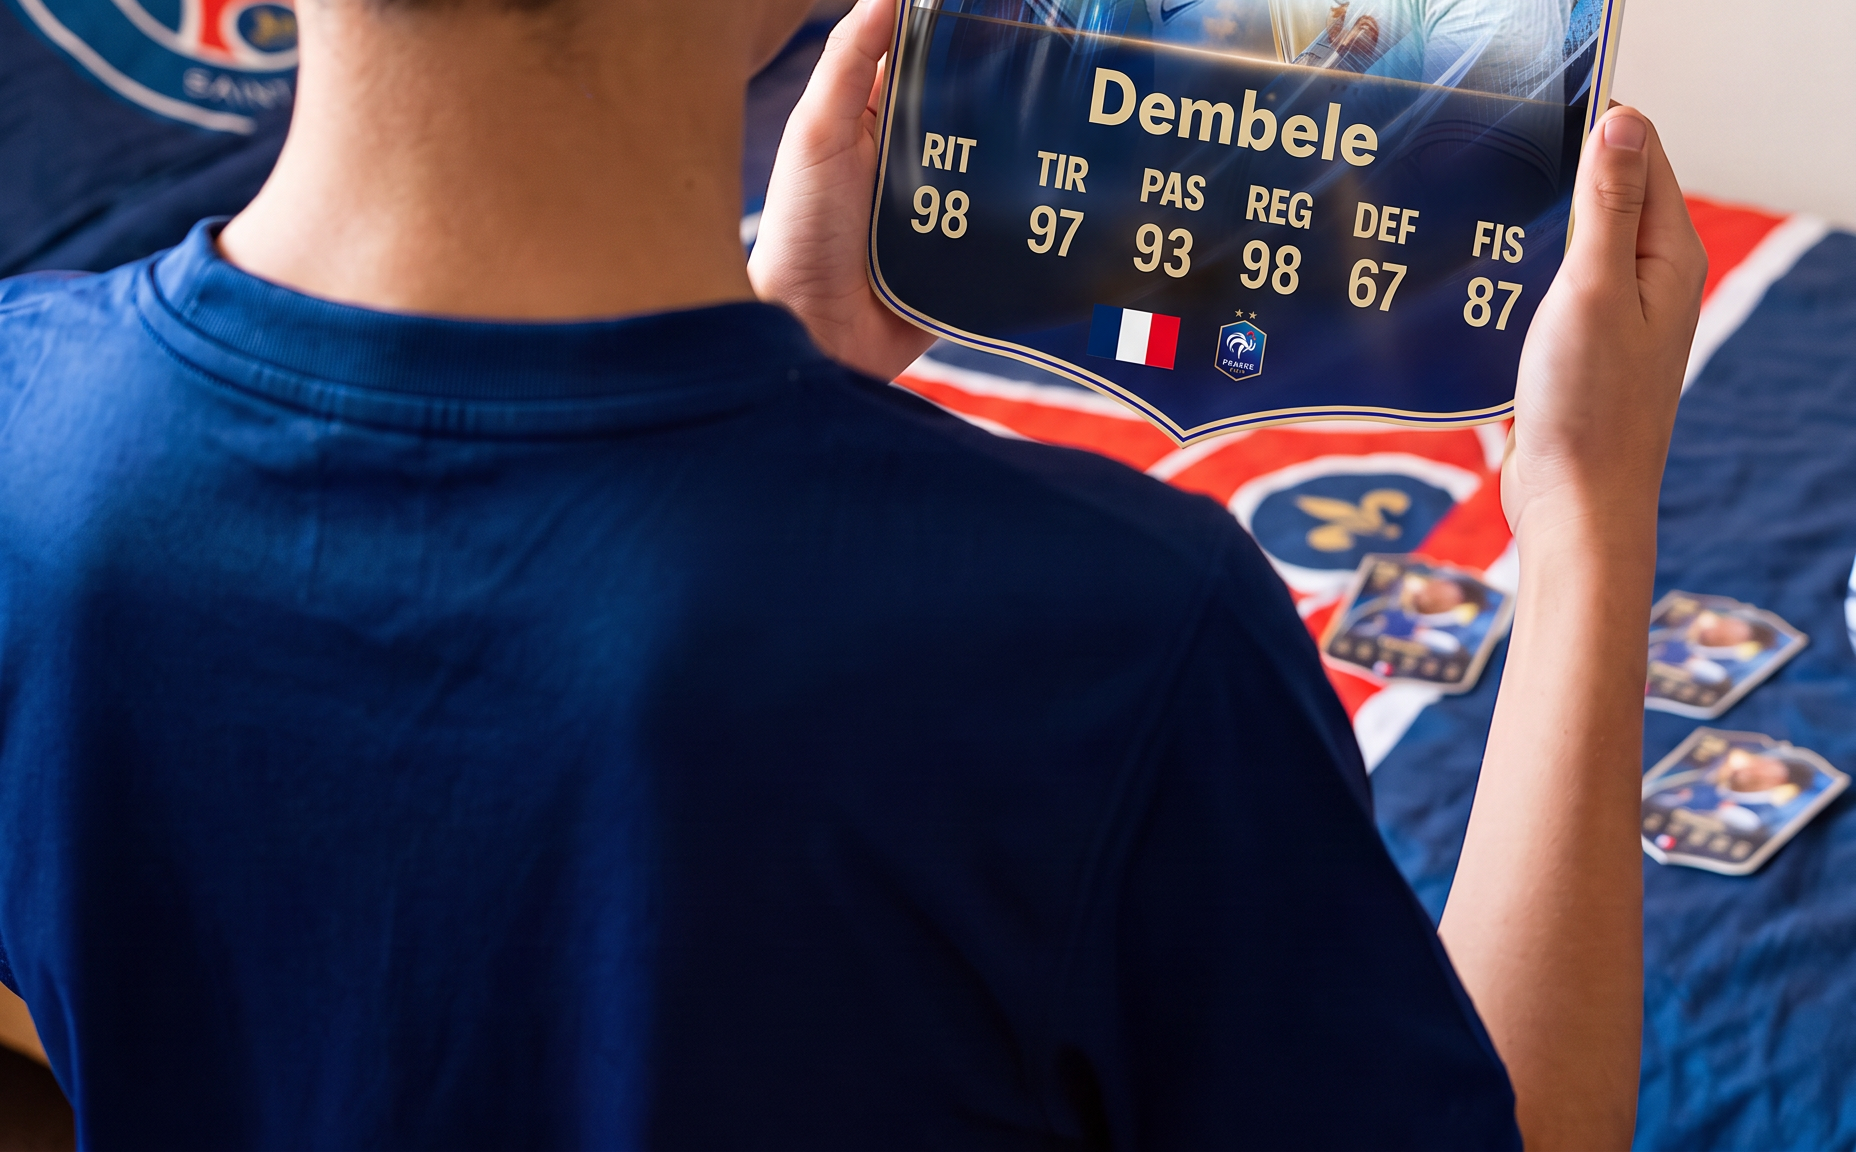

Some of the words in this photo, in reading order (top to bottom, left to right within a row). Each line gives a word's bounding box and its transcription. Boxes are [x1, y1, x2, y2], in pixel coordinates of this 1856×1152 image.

[1088, 66, 1379, 167] Dembele
[910, 185, 970, 239] 98
[1027, 205, 1085, 257] 97
[1133, 223, 1194, 278] 93
[1239, 239, 1302, 295] 98
[1348, 258, 1408, 312] 67
[1463, 276, 1523, 331] 87
[921, 132, 977, 174] RIT
[1037, 150, 1090, 193] TIR
[1139, 167, 1207, 211] PAS
[1245, 184, 1314, 230] REG
[1352, 201, 1420, 245] DEF
[1472, 220, 1526, 264] FIS
